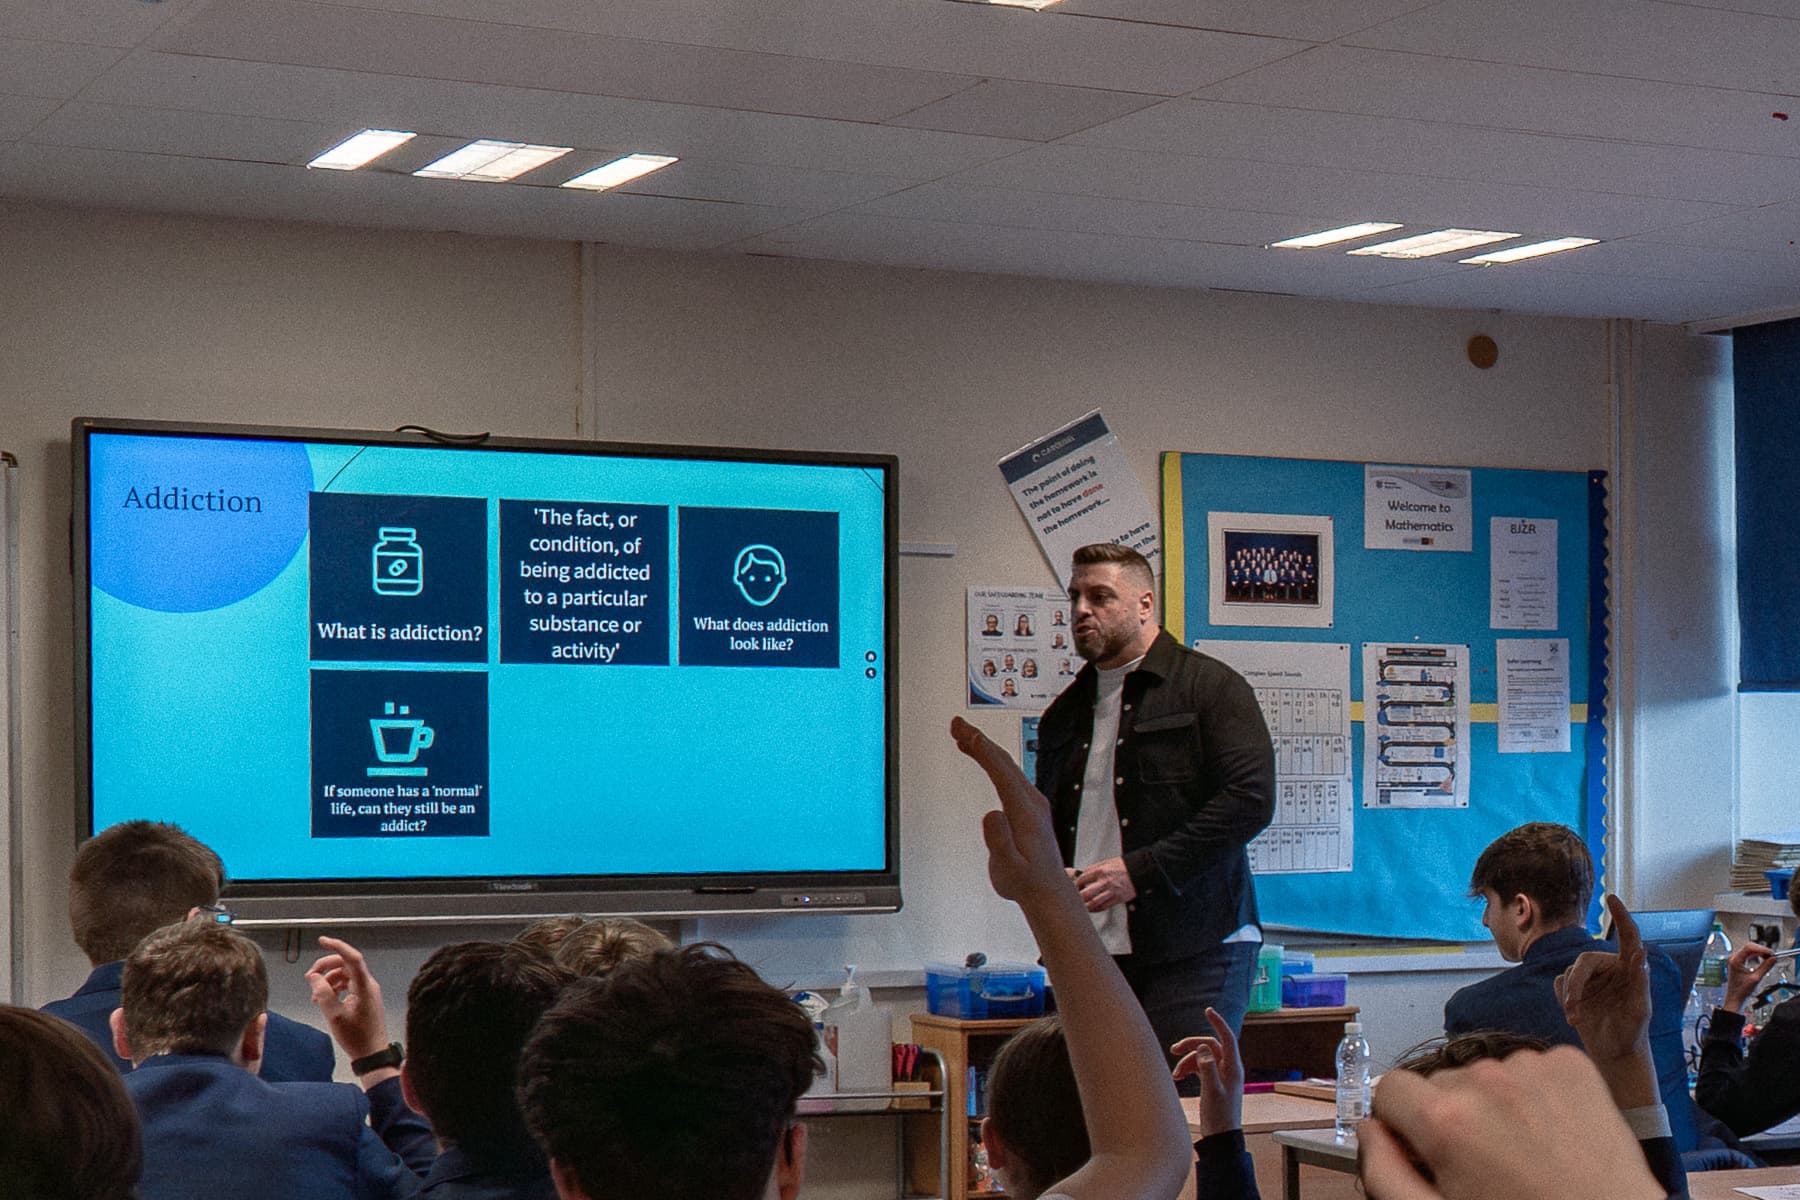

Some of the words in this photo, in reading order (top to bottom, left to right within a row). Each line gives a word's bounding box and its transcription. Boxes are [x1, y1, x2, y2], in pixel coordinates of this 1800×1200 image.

[1022, 485, 1039, 498] The
[1039, 473, 1062, 491] point
[1061, 467, 1071, 477] of
[1070, 455, 1096, 472] doing
[122, 485, 263, 514] Addiction
[1029, 498, 1044, 510] the
[1044, 475, 1089, 503] homework
[1088, 470, 1098, 478] is
[1037, 510, 1052, 522] not
[1051, 505, 1061, 514] to
[1061, 494, 1083, 510] have
[1082, 483, 1104, 498] done
[1387, 499, 1437, 513] Welcome
[1439, 503, 1451, 513] to
[576, 508, 614, 530] fact,
[618, 514, 638, 528] or
[1043, 523, 1058, 535] the
[1385, 519, 1454, 532] Mathematics
[1120, 533, 1130, 542] to
[1129, 521, 1150, 537] have
[529, 535, 620, 557] condition,
[623, 537, 642, 554] of
[520, 560, 571, 583] being
[573, 563, 650, 581] addicted
[524, 589, 543, 605] to
[547, 592, 558, 605] a
[562, 590, 648, 609] particular
[317, 622, 367, 640] What
[371, 623, 386, 640] is
[389, 623, 483, 643] addiction?
[529, 614, 620, 633] substance
[623, 620, 642, 633] or
[693, 616, 730, 631] What
[732, 617, 764, 632] does
[766, 618, 829, 633] addiction
[730, 636, 760, 651] look
[762, 637, 794, 651] like?
[324, 785, 336, 797] If
[337, 787, 395, 798] someone
[397, 785, 420, 797] has
[421, 787, 430, 797] a
[330, 802, 356, 817] life,
[358, 804, 381, 815] can
[384, 802, 412, 817] they
[414, 801, 439, 814] still
[441, 802, 457, 814] be
[459, 804, 476, 814] an
[380, 820, 428, 832] addict?
